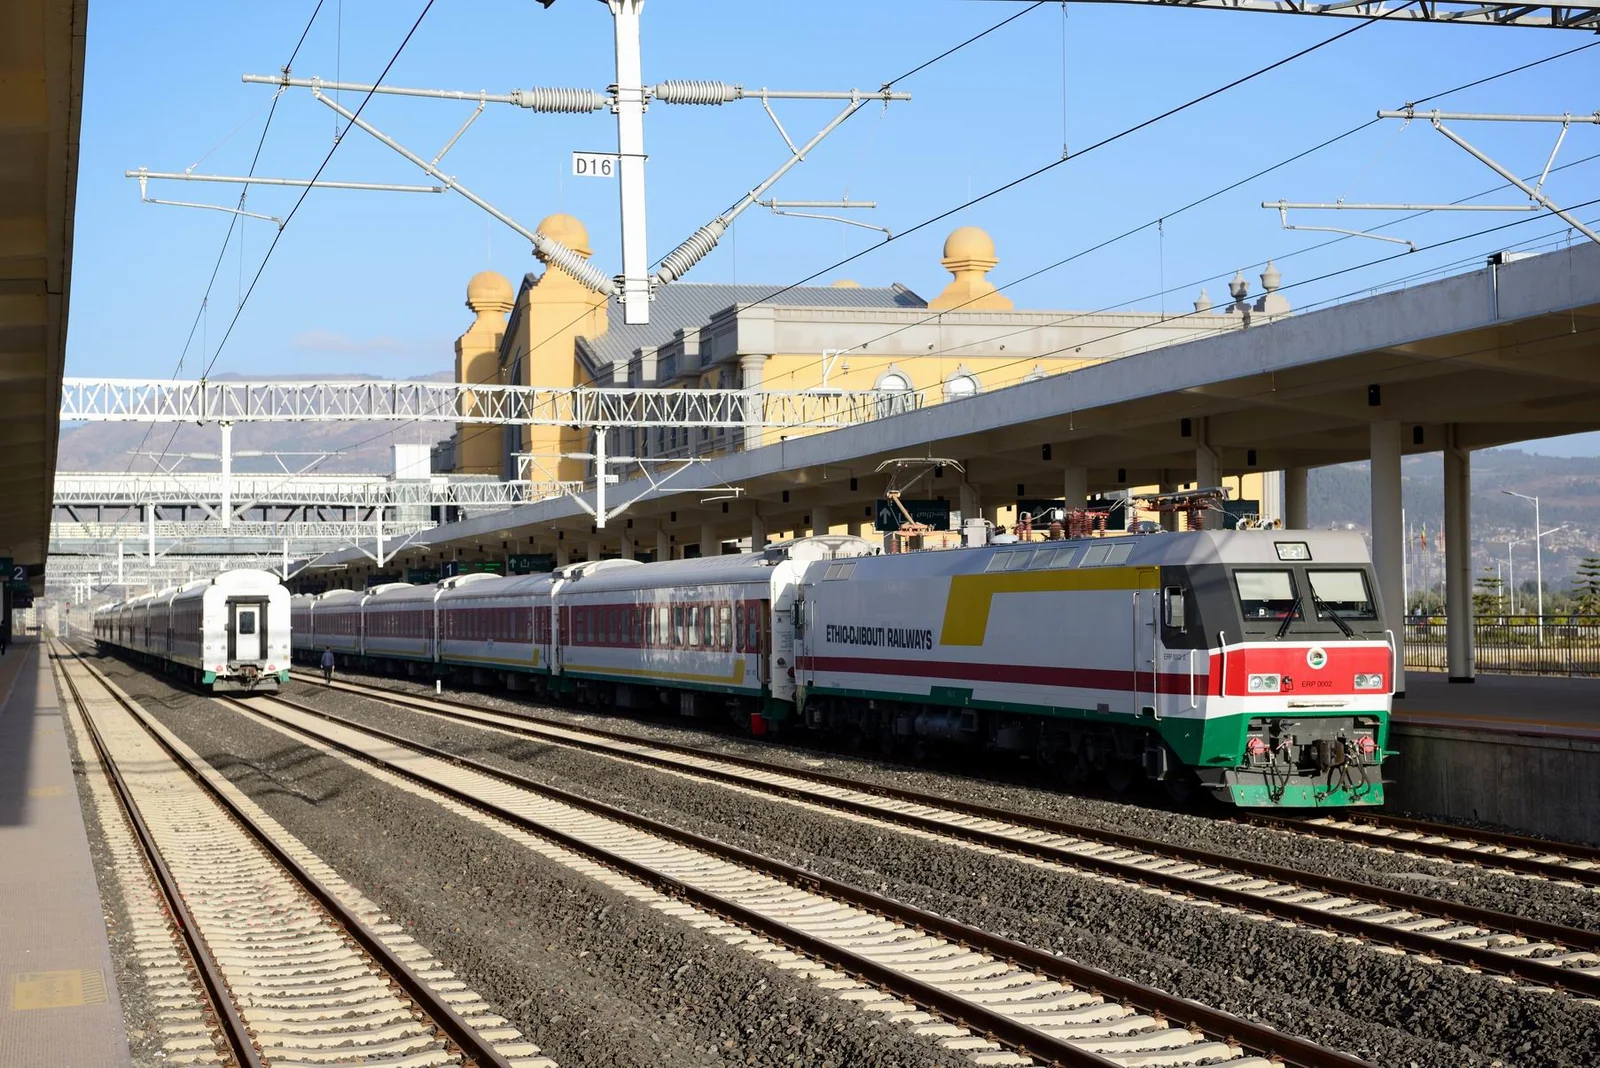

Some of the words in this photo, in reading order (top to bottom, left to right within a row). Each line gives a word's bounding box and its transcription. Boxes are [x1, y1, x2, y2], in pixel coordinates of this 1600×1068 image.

[577, 158, 611, 175] D16
[13, 566, 24, 580] 2
[446, 563, 452, 576] 1
[826, 624, 885, 647] ETHIO-DJIBOUTI
[887, 628, 933, 650] RAILWAYS
[1301, 680, 1316, 688] ERP
[1317, 680, 1333, 688] 0002
